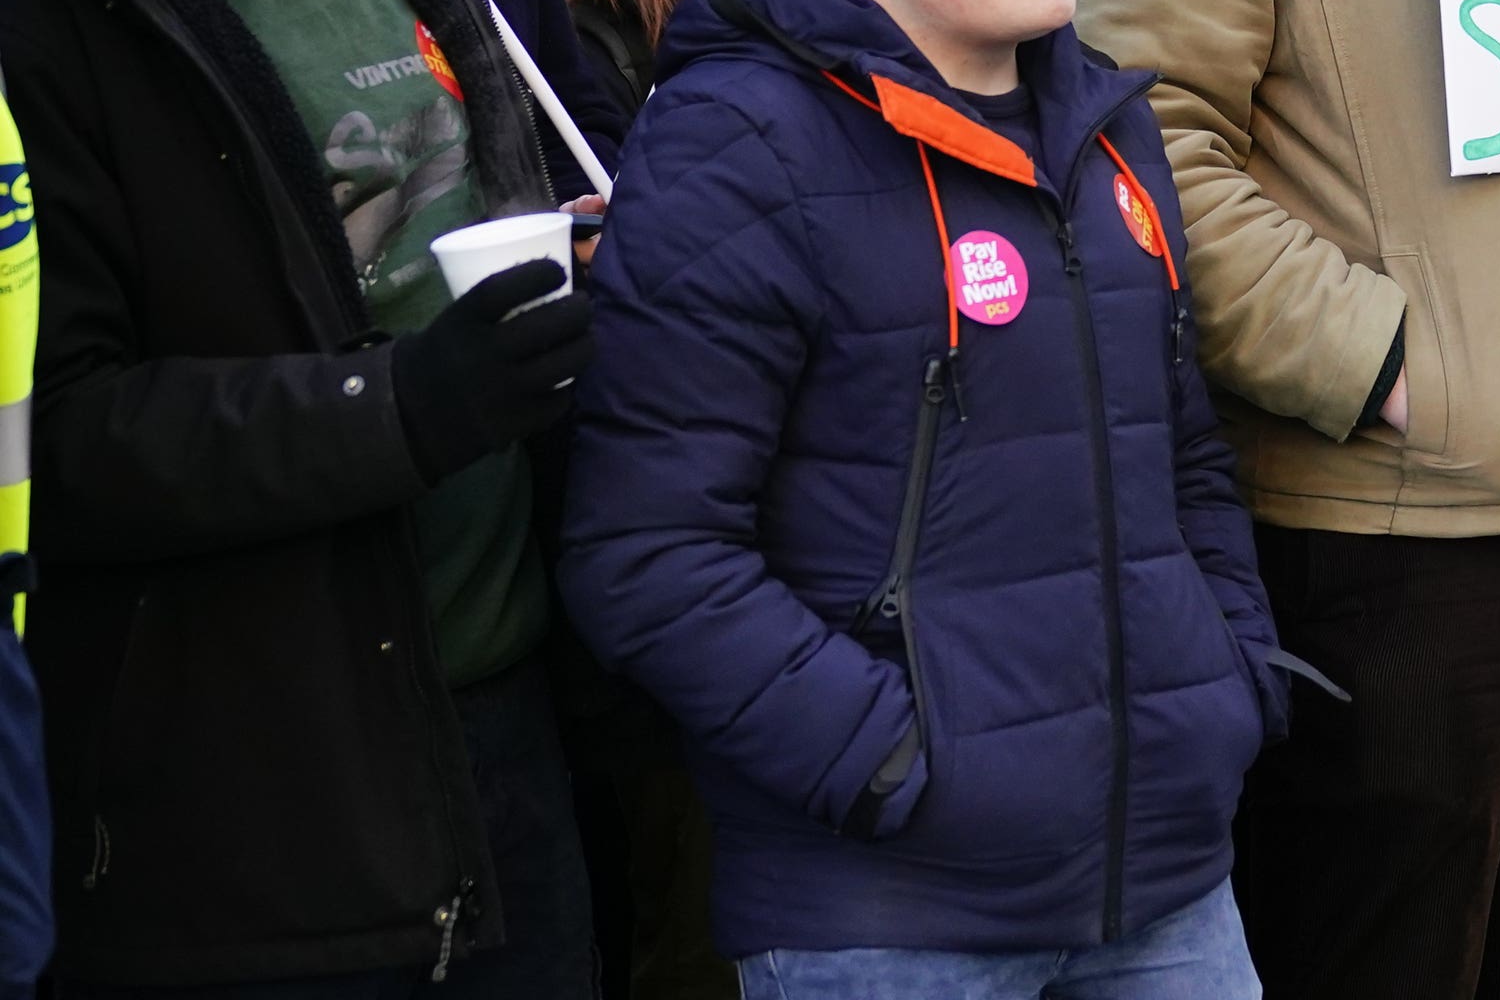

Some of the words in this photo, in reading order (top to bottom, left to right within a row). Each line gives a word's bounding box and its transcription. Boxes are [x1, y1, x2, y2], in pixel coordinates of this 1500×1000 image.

[959, 240, 998, 264] Pay
[962, 259, 1007, 285] Rise
[961, 274, 1018, 306] Now!
[985, 301, 1010, 319] pcs
